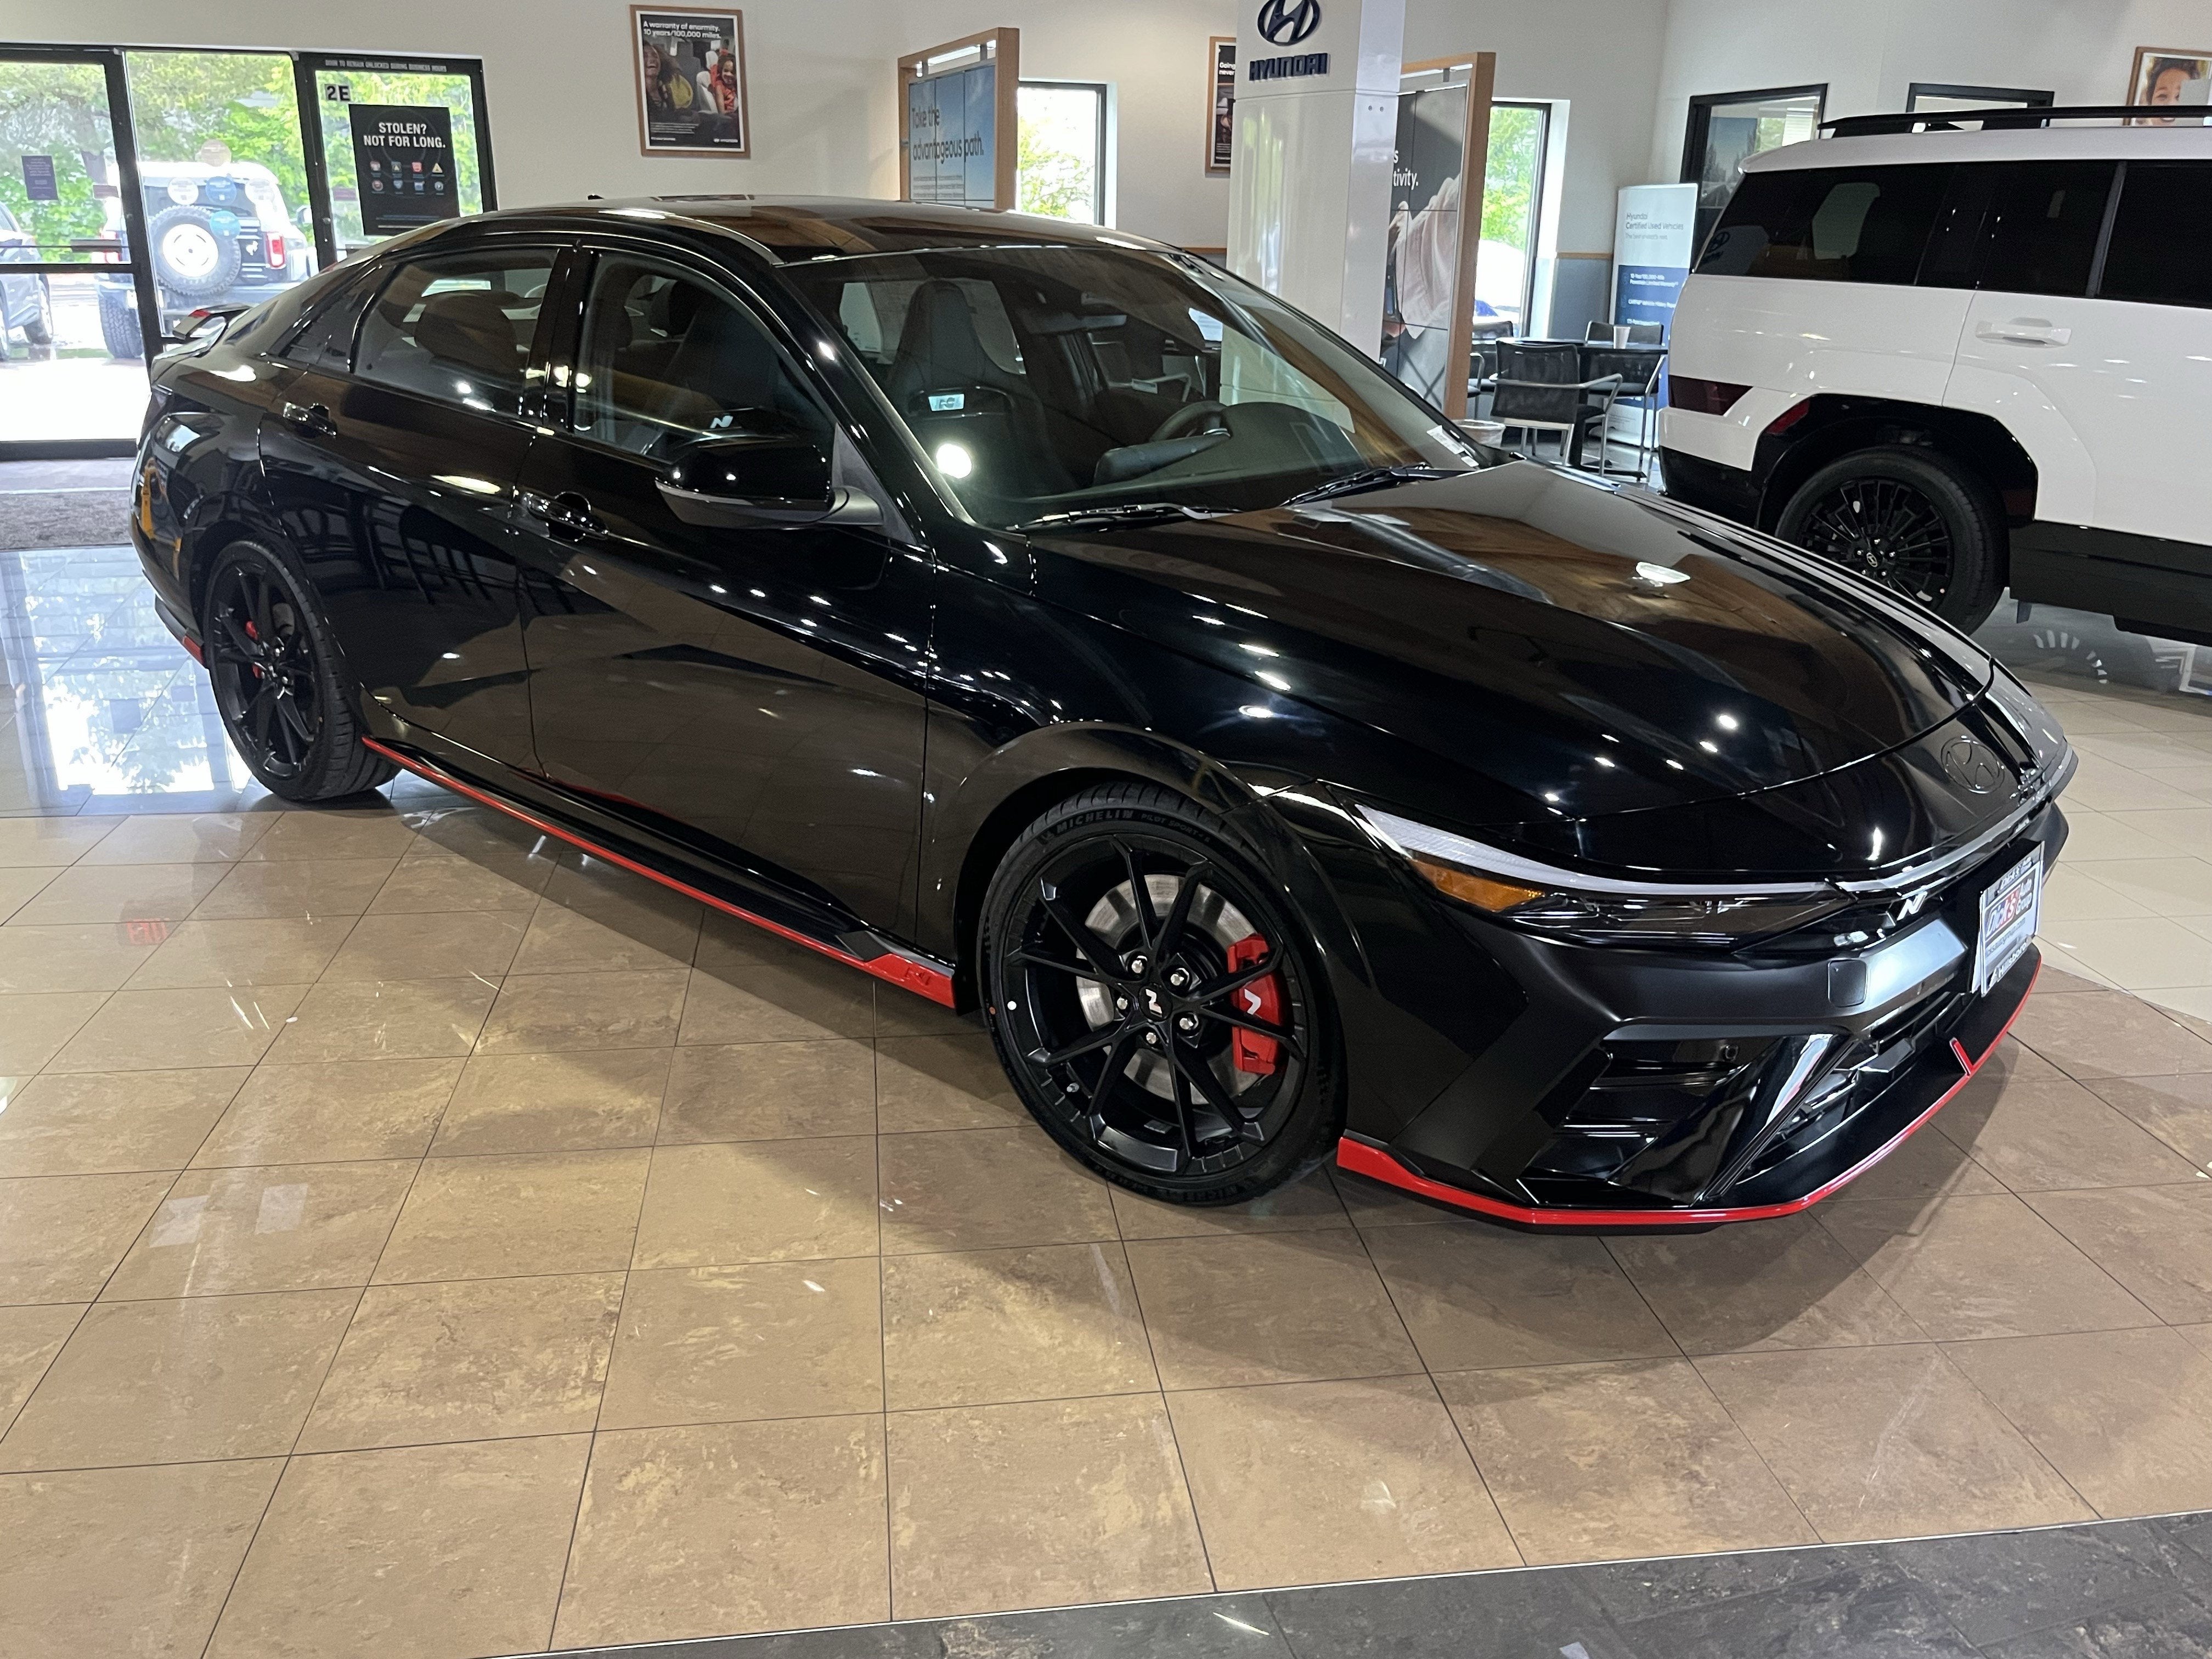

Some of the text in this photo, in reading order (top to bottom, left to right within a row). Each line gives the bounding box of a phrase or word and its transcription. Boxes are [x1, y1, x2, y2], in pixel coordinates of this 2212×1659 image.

[1249, 53, 1328, 81] HYUNDAI
[326, 85, 351, 101] 2E
[912, 103, 939, 128] Take the
[379, 122, 427, 134] STOLEN?
[363, 135, 446, 148] NOT FOR LONG.
[913, 131, 984, 164] advantageous path.
[1057, 810, 1134, 834] MICHELIN
[1999, 942, 2027, 978] Hillsboro
